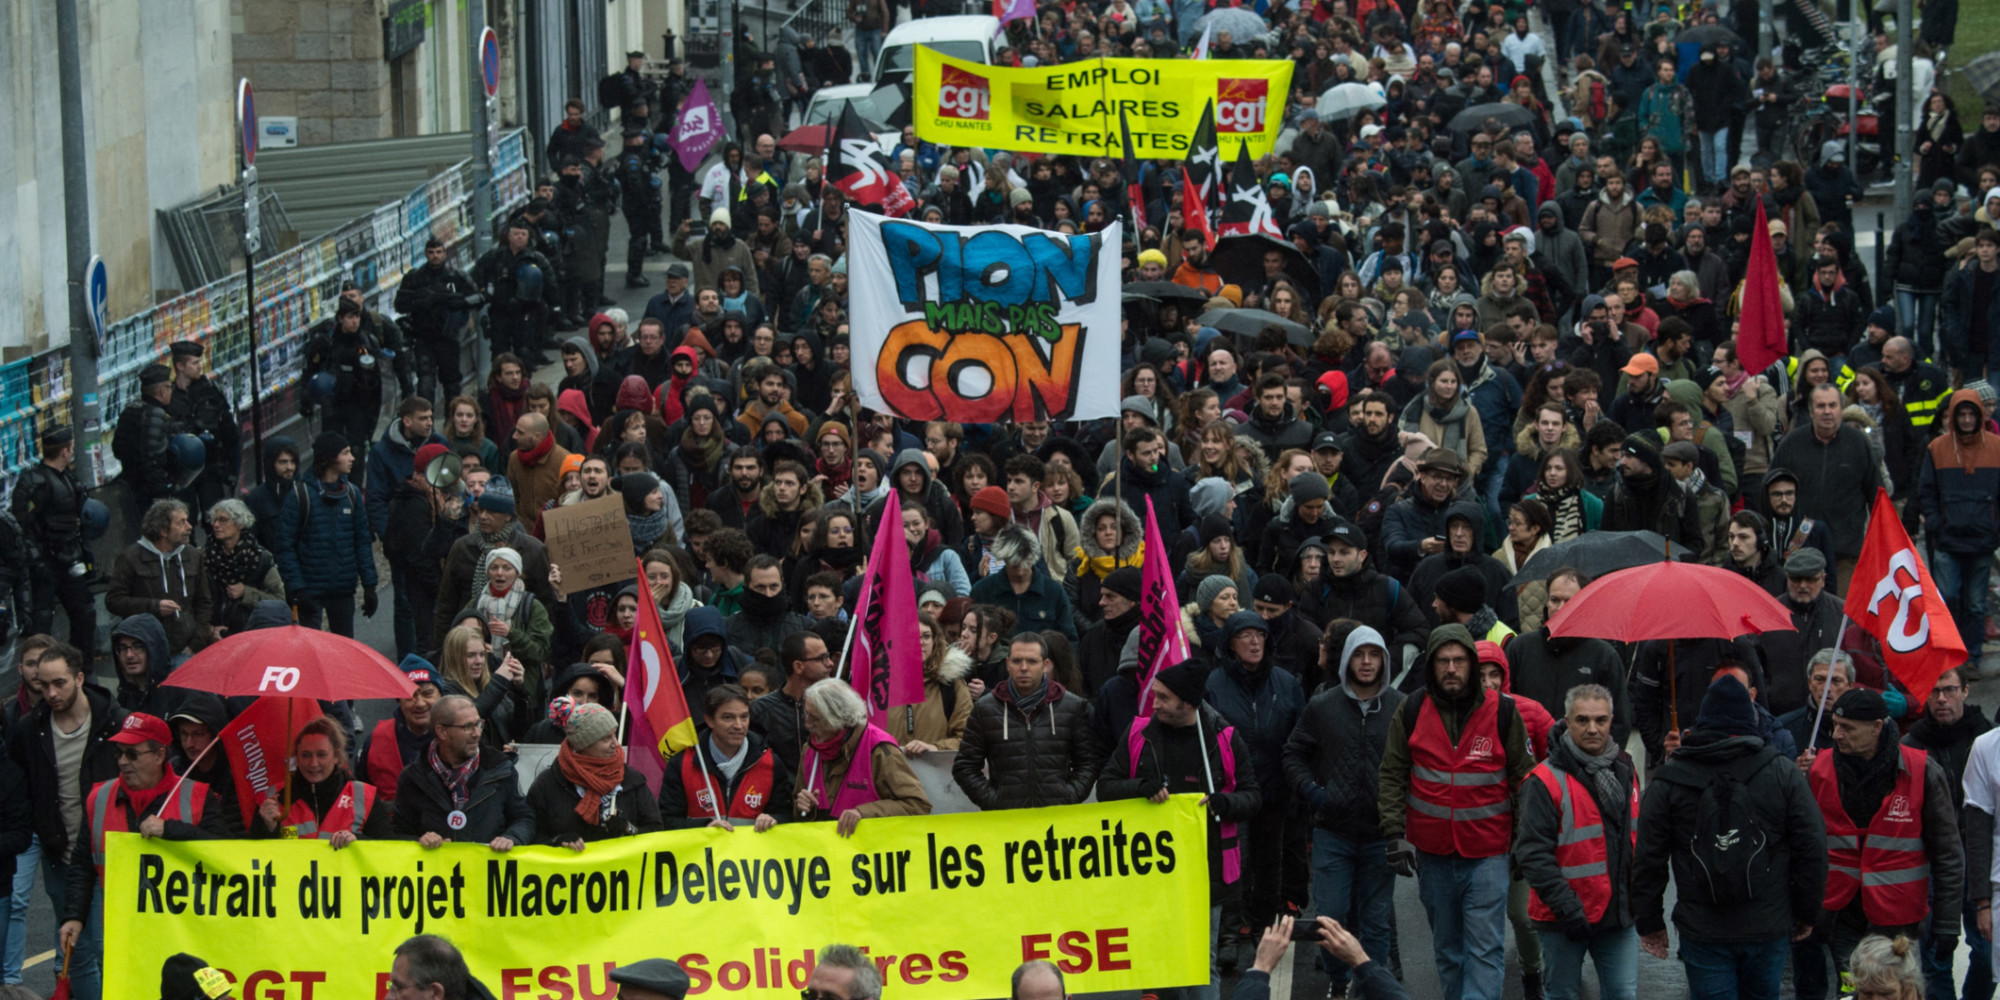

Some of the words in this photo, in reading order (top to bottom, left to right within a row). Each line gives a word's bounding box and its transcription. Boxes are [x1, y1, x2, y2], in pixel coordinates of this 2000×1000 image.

[1047, 68, 1160, 90] EMPLOI
[939, 85, 991, 117] cgt
[1026, 100, 1180, 118] SALAIRES
[1216, 96, 1267, 132] cgt
[934, 118, 953, 128] CHU
[956, 120, 992, 131] NANTES
[1015, 125, 1188, 151] RETRATES
[1217, 135, 1232, 144] HU
[880, 220, 1102, 314] PION
[925, 300, 1004, 335] MAIS
[1008, 302, 1063, 343] PAS
[876, 318, 1088, 423] CON
[258, 666, 301, 692] FO
[744, 792, 763, 809] cgt
[450, 815, 464, 827] FO
[137, 853, 277, 919] Retrait
[299, 860, 343, 920] du
[361, 859, 466, 935] projet
[852, 850, 910, 896] sur
[928, 832, 986, 891] les
[1004, 818, 1177, 885] retraites
[501, 961, 619, 1000] FSU
[677, 945, 970, 995] Solidres
[1021, 927, 1132, 974] FSE
